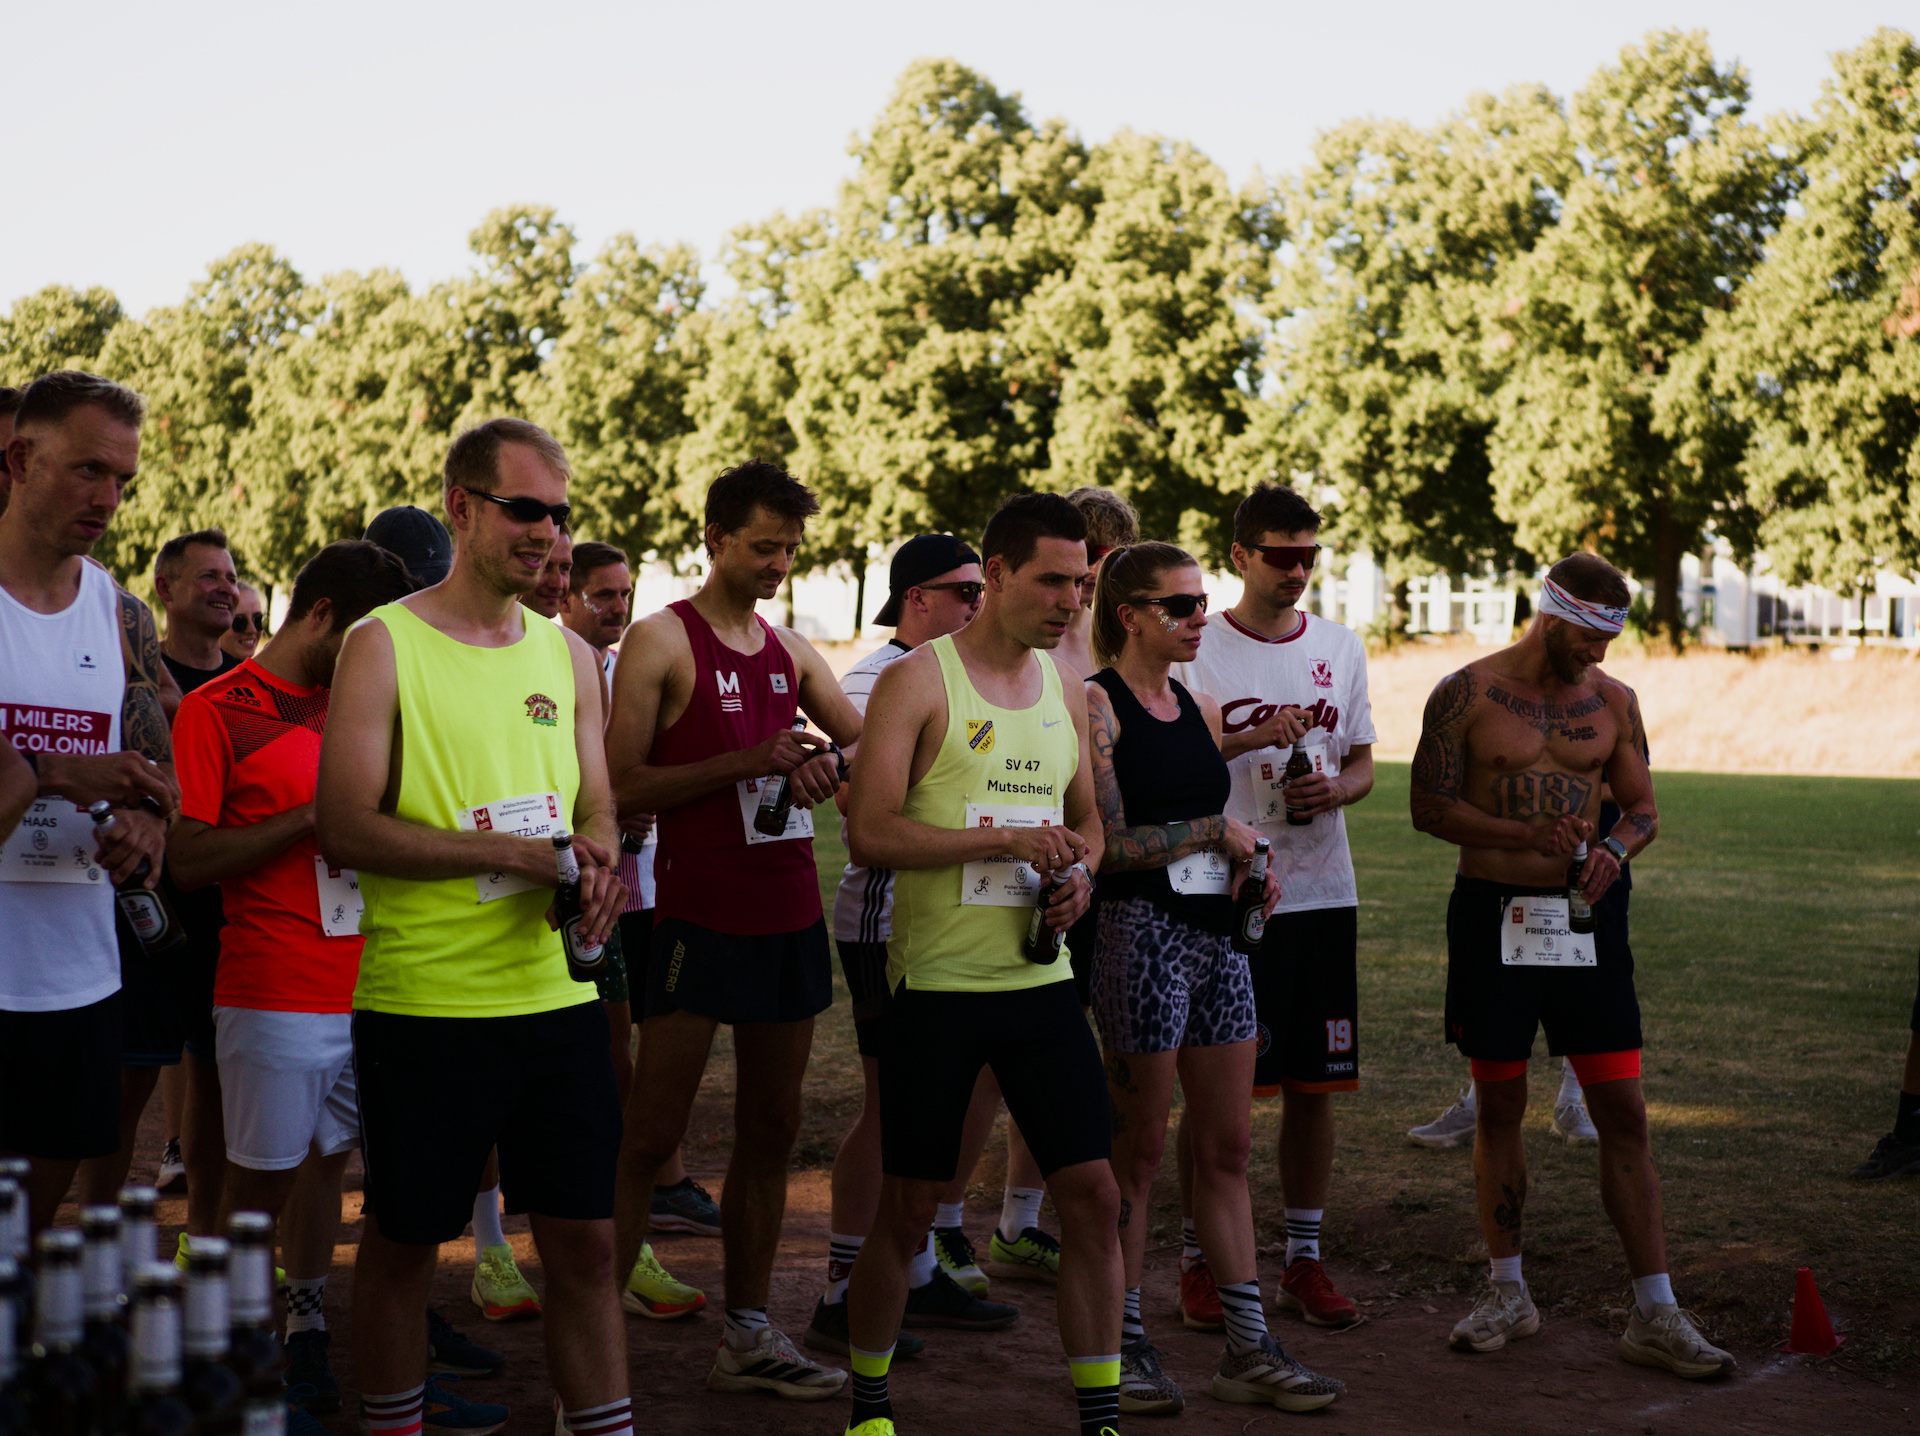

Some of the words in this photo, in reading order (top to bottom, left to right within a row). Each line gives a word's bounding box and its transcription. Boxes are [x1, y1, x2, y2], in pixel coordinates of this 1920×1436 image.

[715, 670, 740, 697] M
[222, 695, 261, 707] adidas
[14, 708, 93, 732] MILERS
[970, 722, 992, 748] MUTSCHEID
[1560, 726, 1594, 737] SILBER
[11, 732, 106, 755] COLONIA
[980, 736, 992, 751] 1947
[1005, 758, 1021, 771] SV
[1024, 760, 1040, 772] 47
[987, 779, 1053, 795] Mutscheid
[1490, 770, 1592, 820] 1987
[34, 804, 47, 812] 27
[23, 817, 57, 827] HAAS
[509, 825, 549, 837] TZLAFF
[1525, 927, 1571, 936] FRIEDRICH
[665, 938, 686, 993] ADIZERO
[1325, 1018, 1353, 1054] 19
[1327, 1062, 1353, 1072] TNKD
